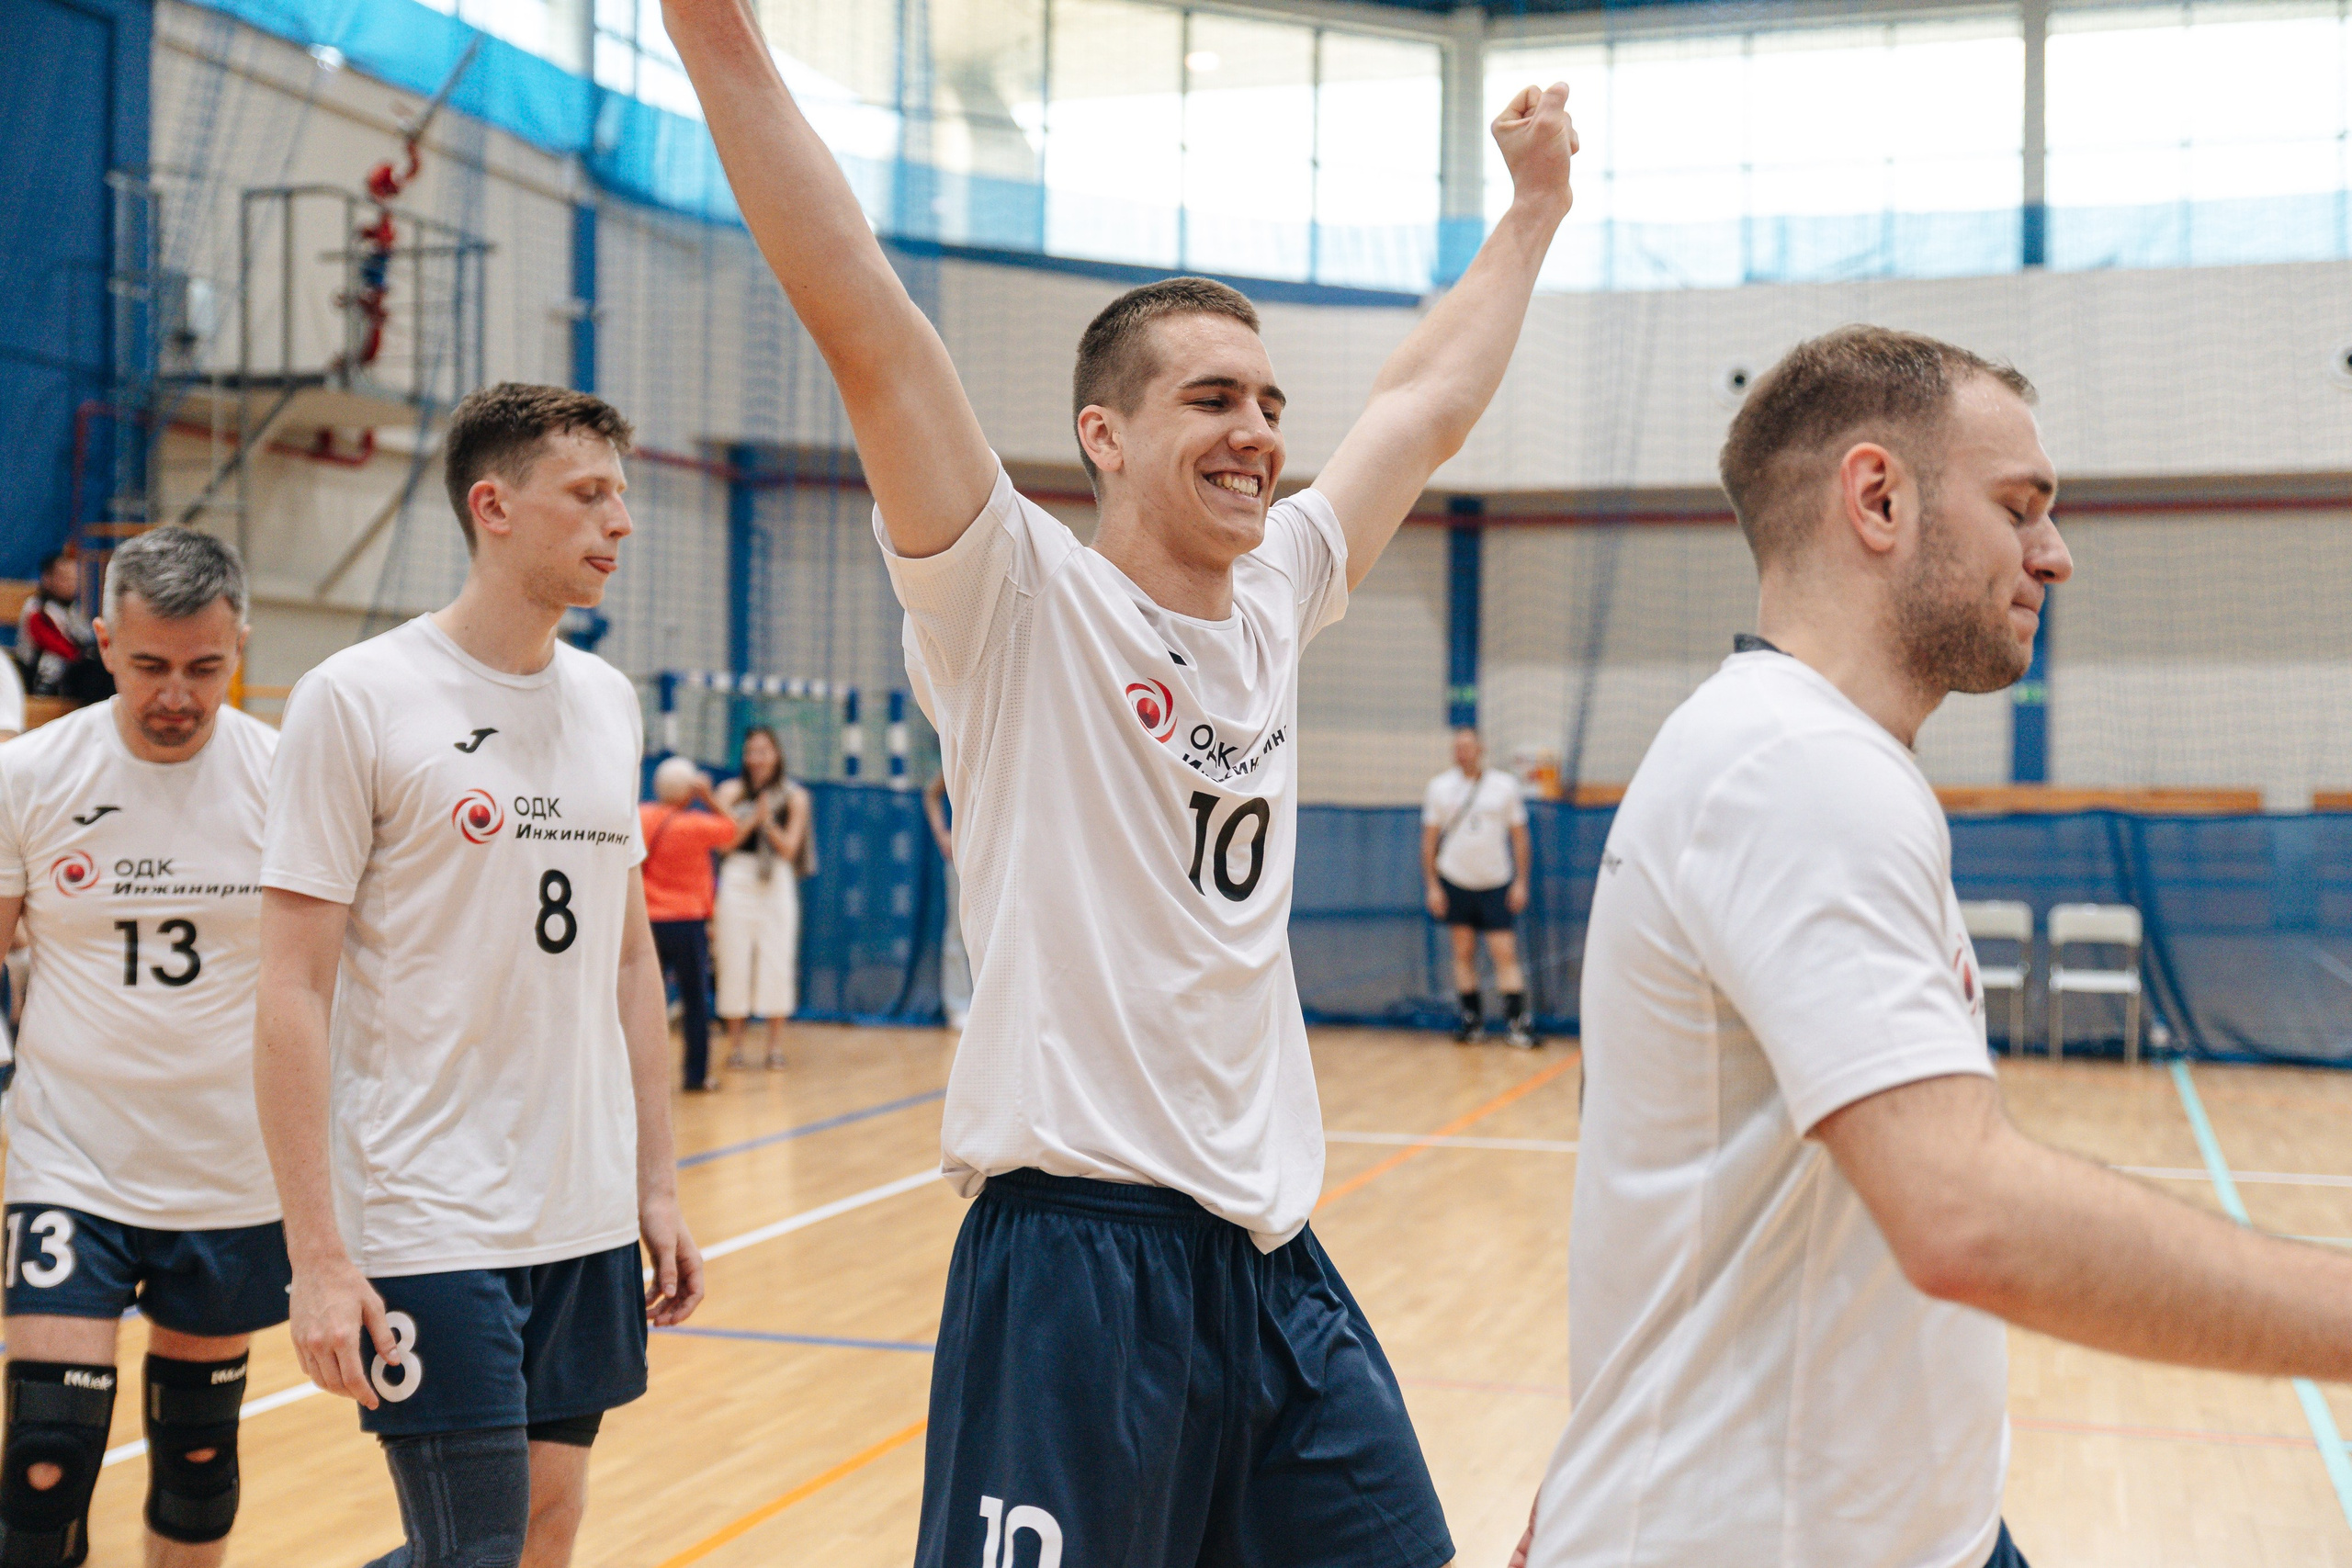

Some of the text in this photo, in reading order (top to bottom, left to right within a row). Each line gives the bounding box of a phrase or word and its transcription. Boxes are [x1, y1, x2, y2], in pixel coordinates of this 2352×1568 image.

[514, 795, 562, 820] ОДК
[515, 824, 629, 845] Инжиниринг
[114, 859, 175, 878] ОДК
[1188, 790, 1270, 902] 10
[112, 883, 263, 897] Инжинирин
[535, 869, 577, 954] 8
[114, 919, 201, 987] 13
[6, 1211, 73, 1288] 13
[371, 1311, 422, 1403] 8
[979, 1495, 1063, 1568] 10
